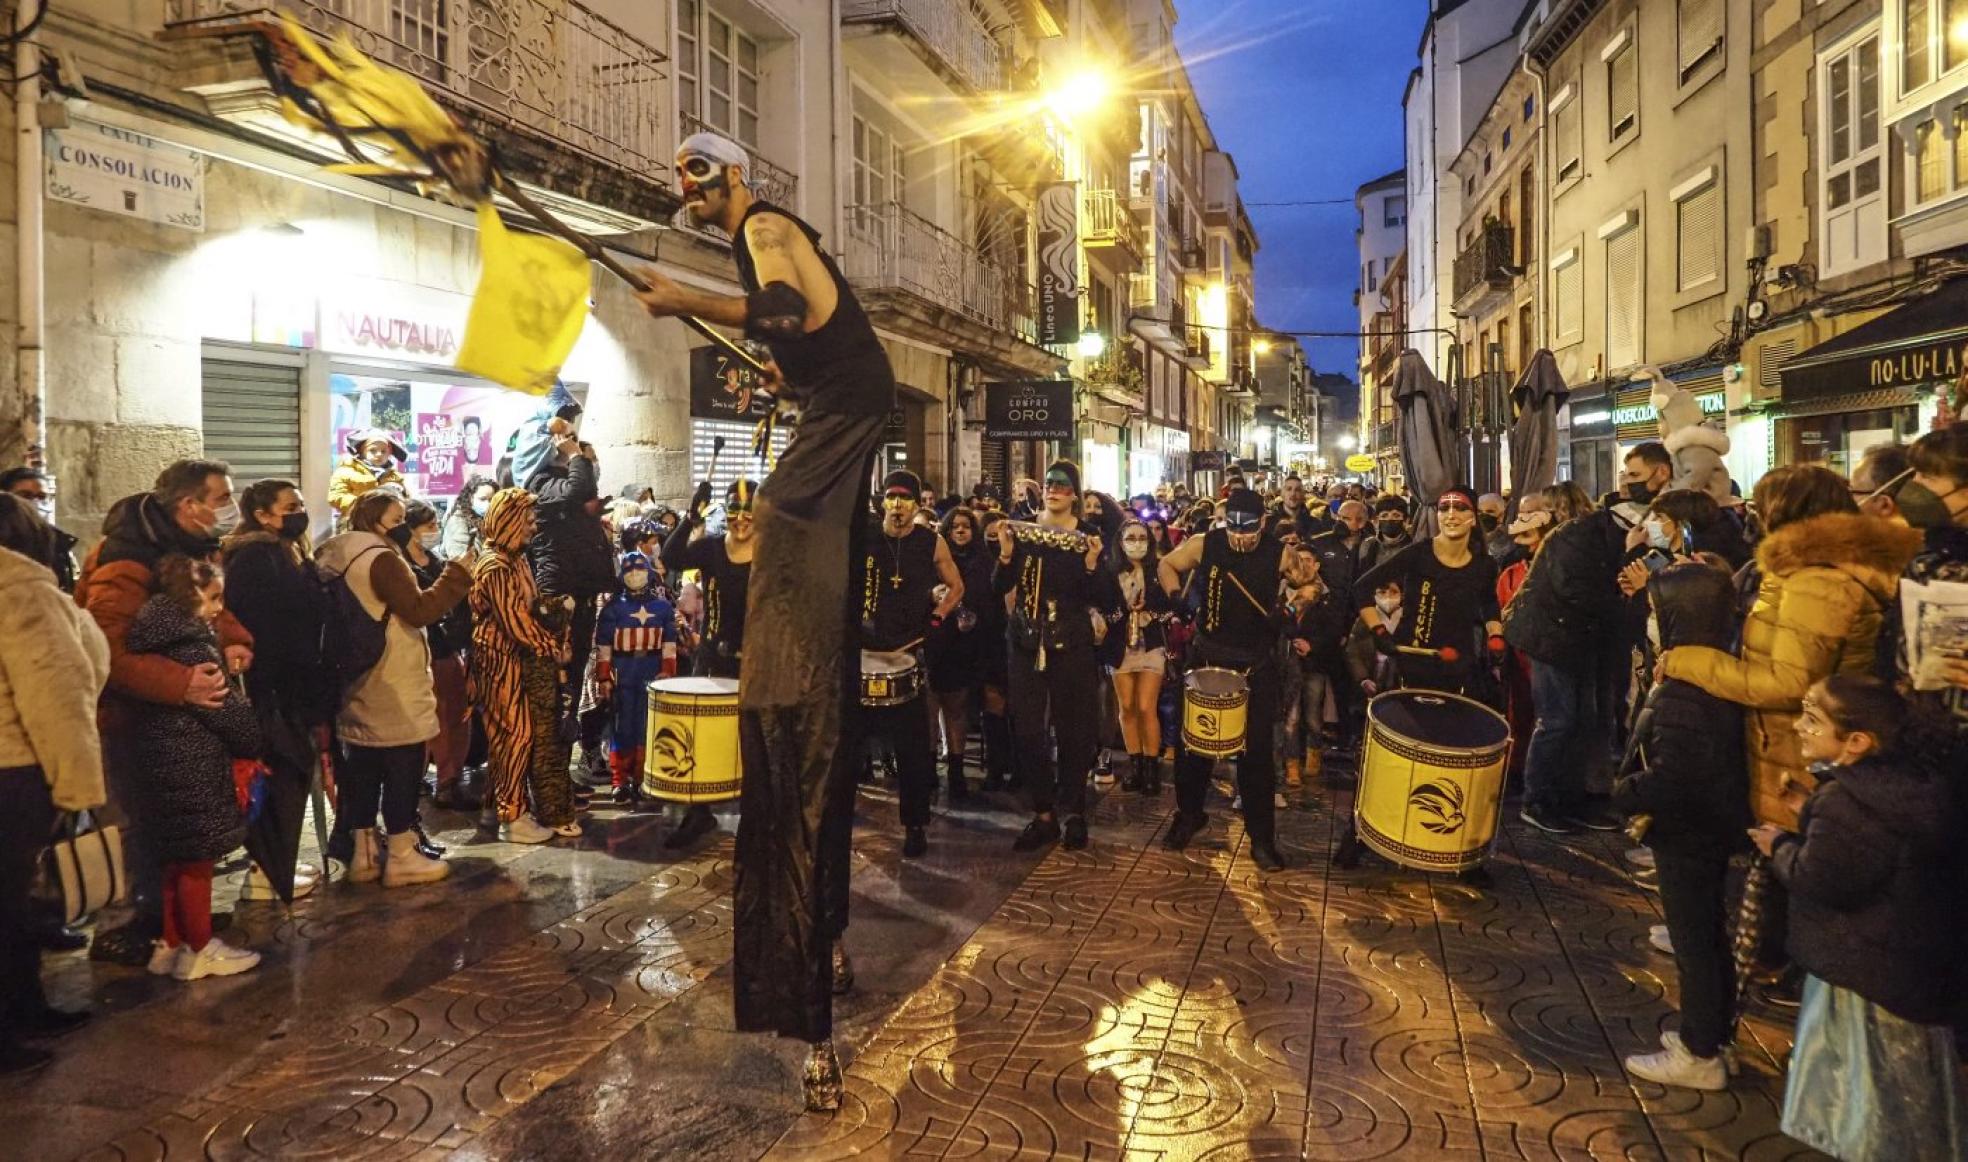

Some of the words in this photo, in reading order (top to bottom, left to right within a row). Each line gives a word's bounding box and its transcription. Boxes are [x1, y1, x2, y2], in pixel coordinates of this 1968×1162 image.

[100, 125, 156, 148] CALLE
[59, 145, 194, 191] CONSOLACION
[337, 310, 458, 351] NAUTALIA
[1008, 409, 1048, 421] ORO
